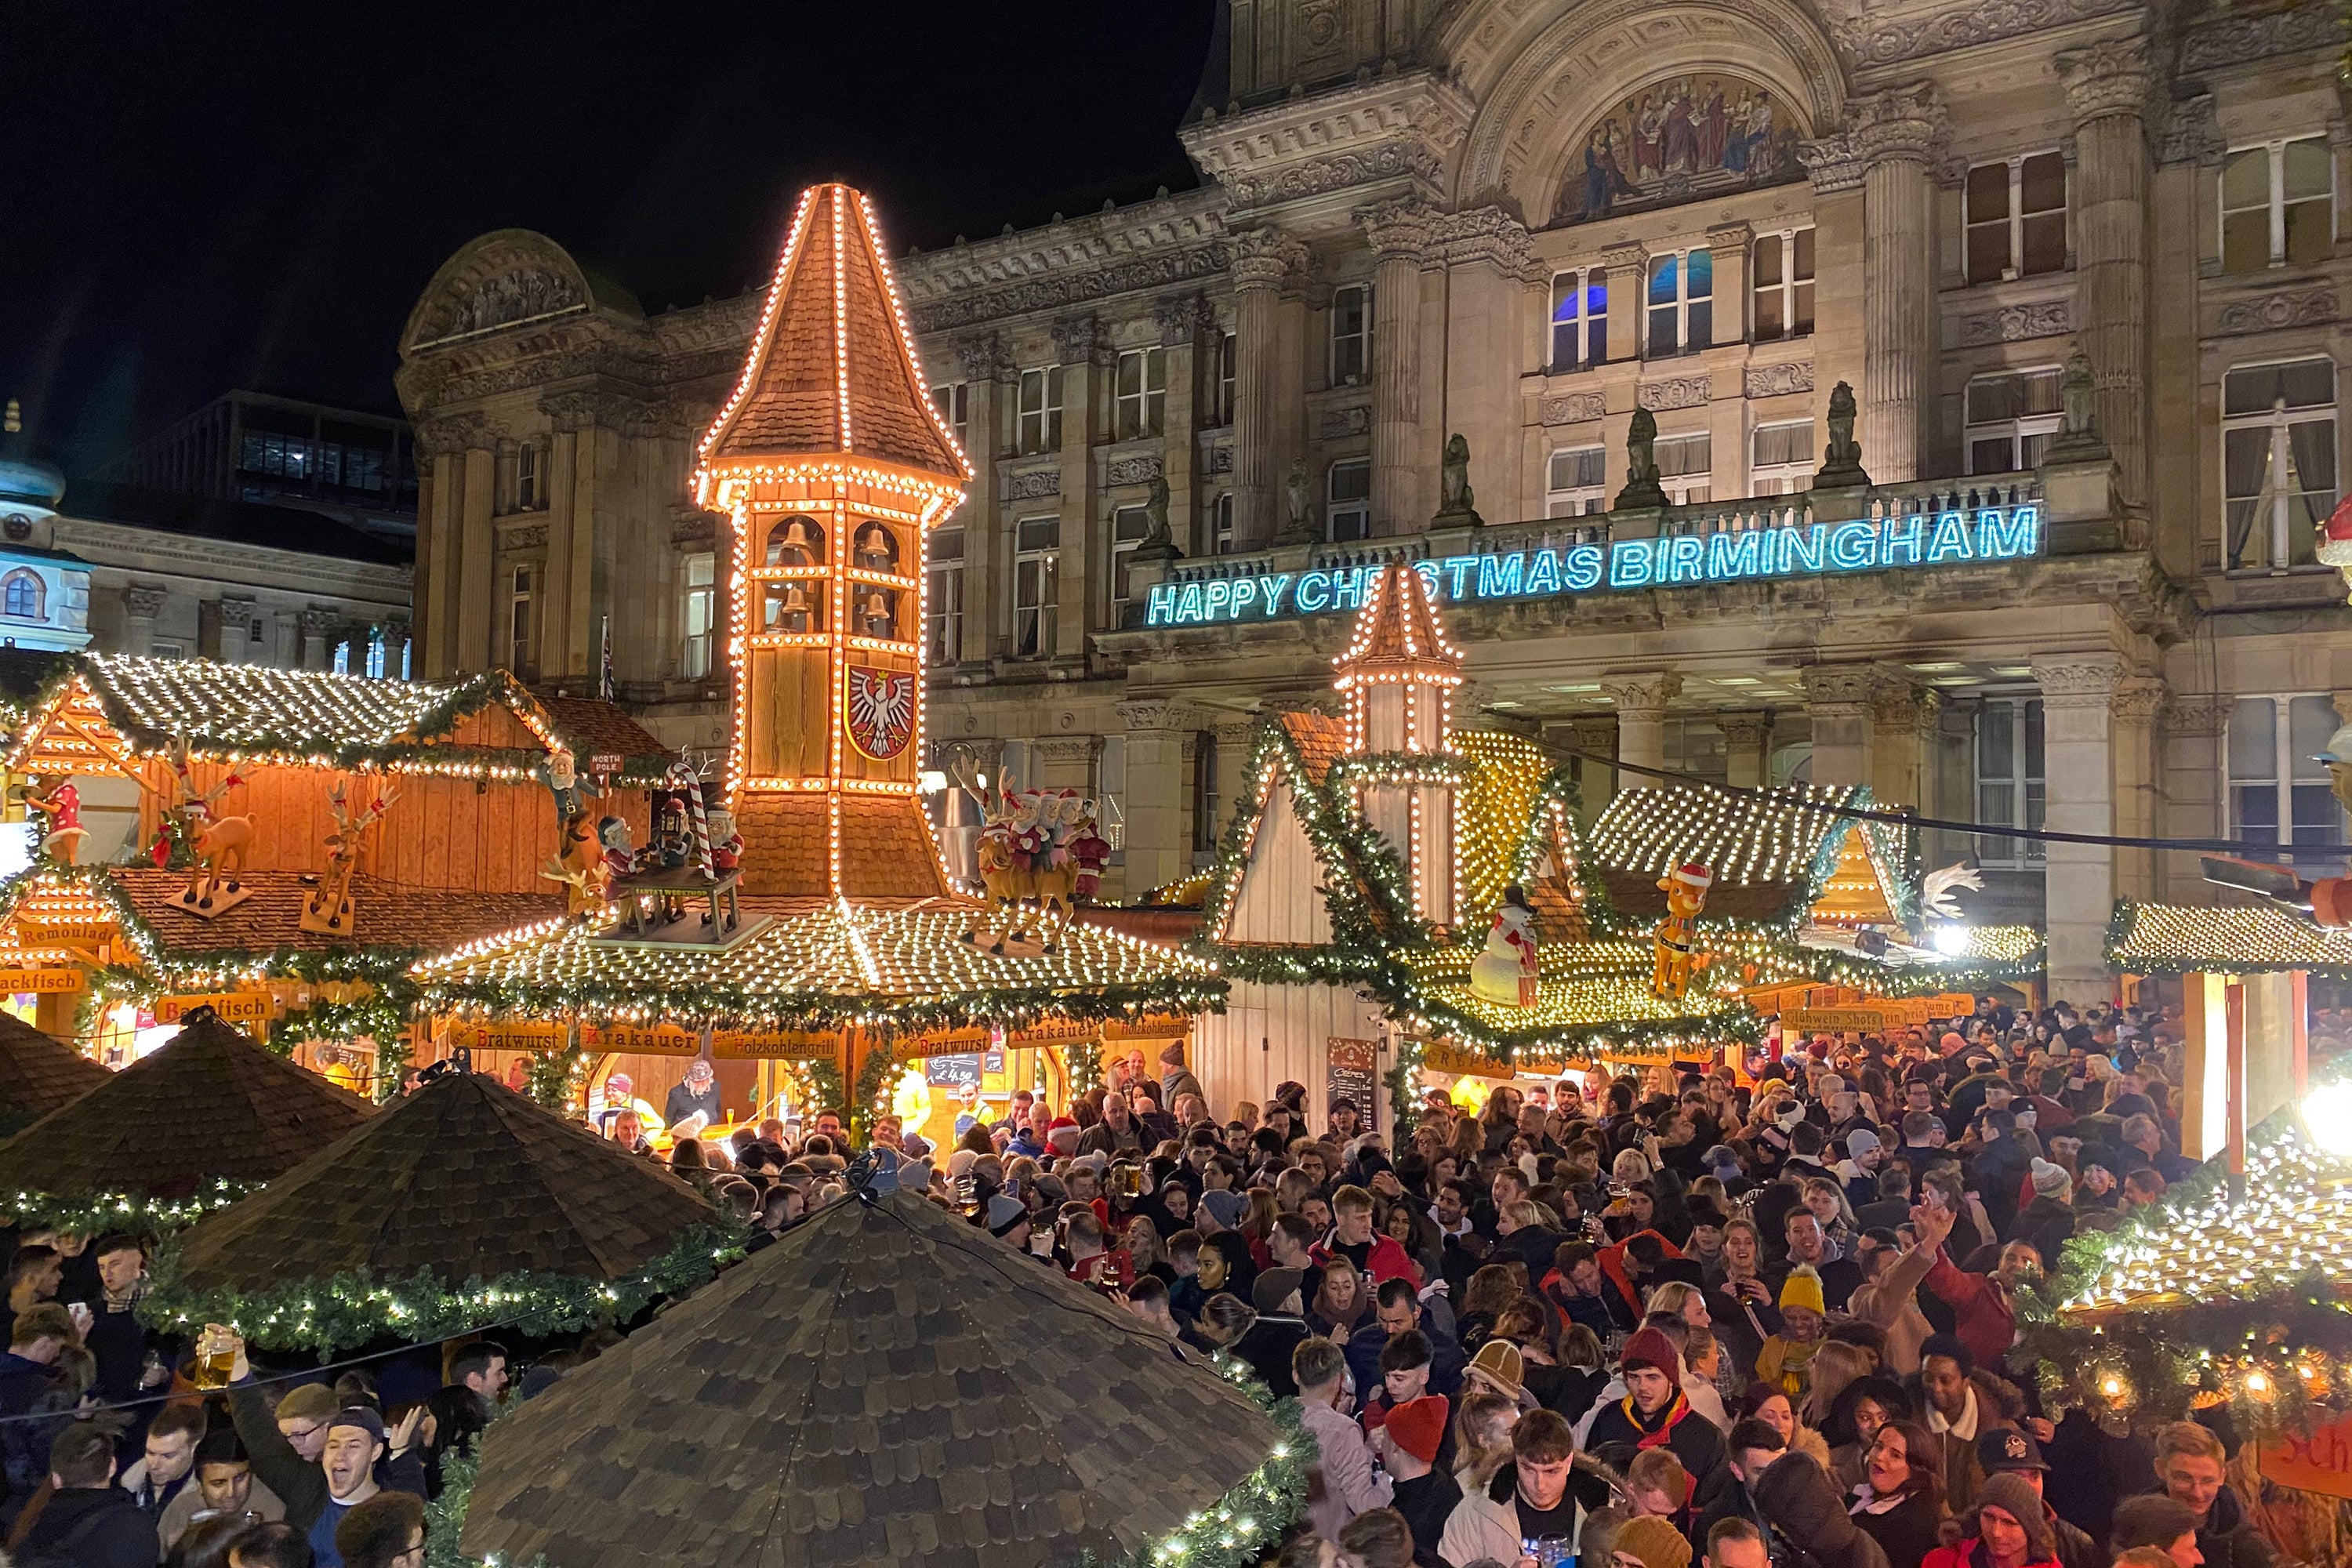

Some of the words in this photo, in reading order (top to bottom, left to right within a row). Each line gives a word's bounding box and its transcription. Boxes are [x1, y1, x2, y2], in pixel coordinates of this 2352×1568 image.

[1147, 573, 1290, 626] HAPPY
[1295, 546, 1602, 613] CHRSTMAS
[1610, 506, 2038, 588] BIRMINGHAM
[165, 996, 265, 1020] Bafisch
[1785, 1011, 1839, 1025] Glühwein
[1846, 1011, 1877, 1025] Shots
[1121, 1019, 1187, 1036] Holzkohlengrill
[477, 1029, 560, 1049] Bratwurst
[586, 1028, 695, 1048] Krakauer
[734, 1038, 834, 1058] Holzkohlengrill
[919, 1033, 988, 1056] Bratwurst
